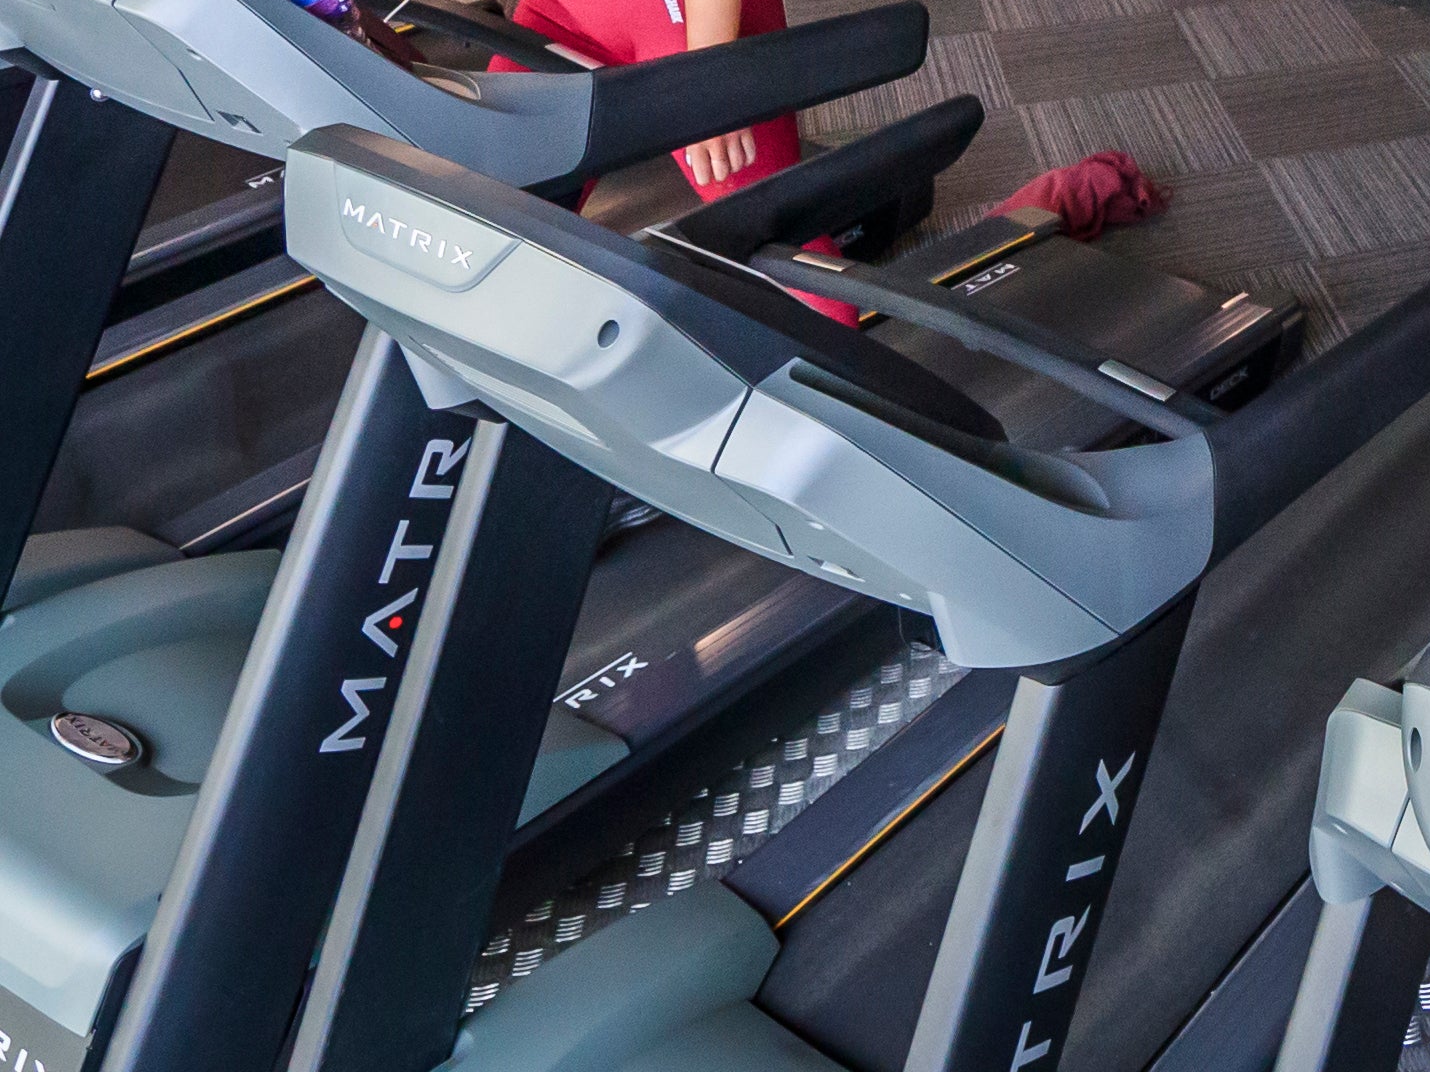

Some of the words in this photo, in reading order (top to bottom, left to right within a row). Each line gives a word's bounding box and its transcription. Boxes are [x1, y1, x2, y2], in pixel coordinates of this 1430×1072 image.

[343, 198, 473, 269] MATRIX
[319, 436, 472, 753] MATR
[564, 656, 649, 709] RIX
[1010, 750, 1136, 1072] TRIX
